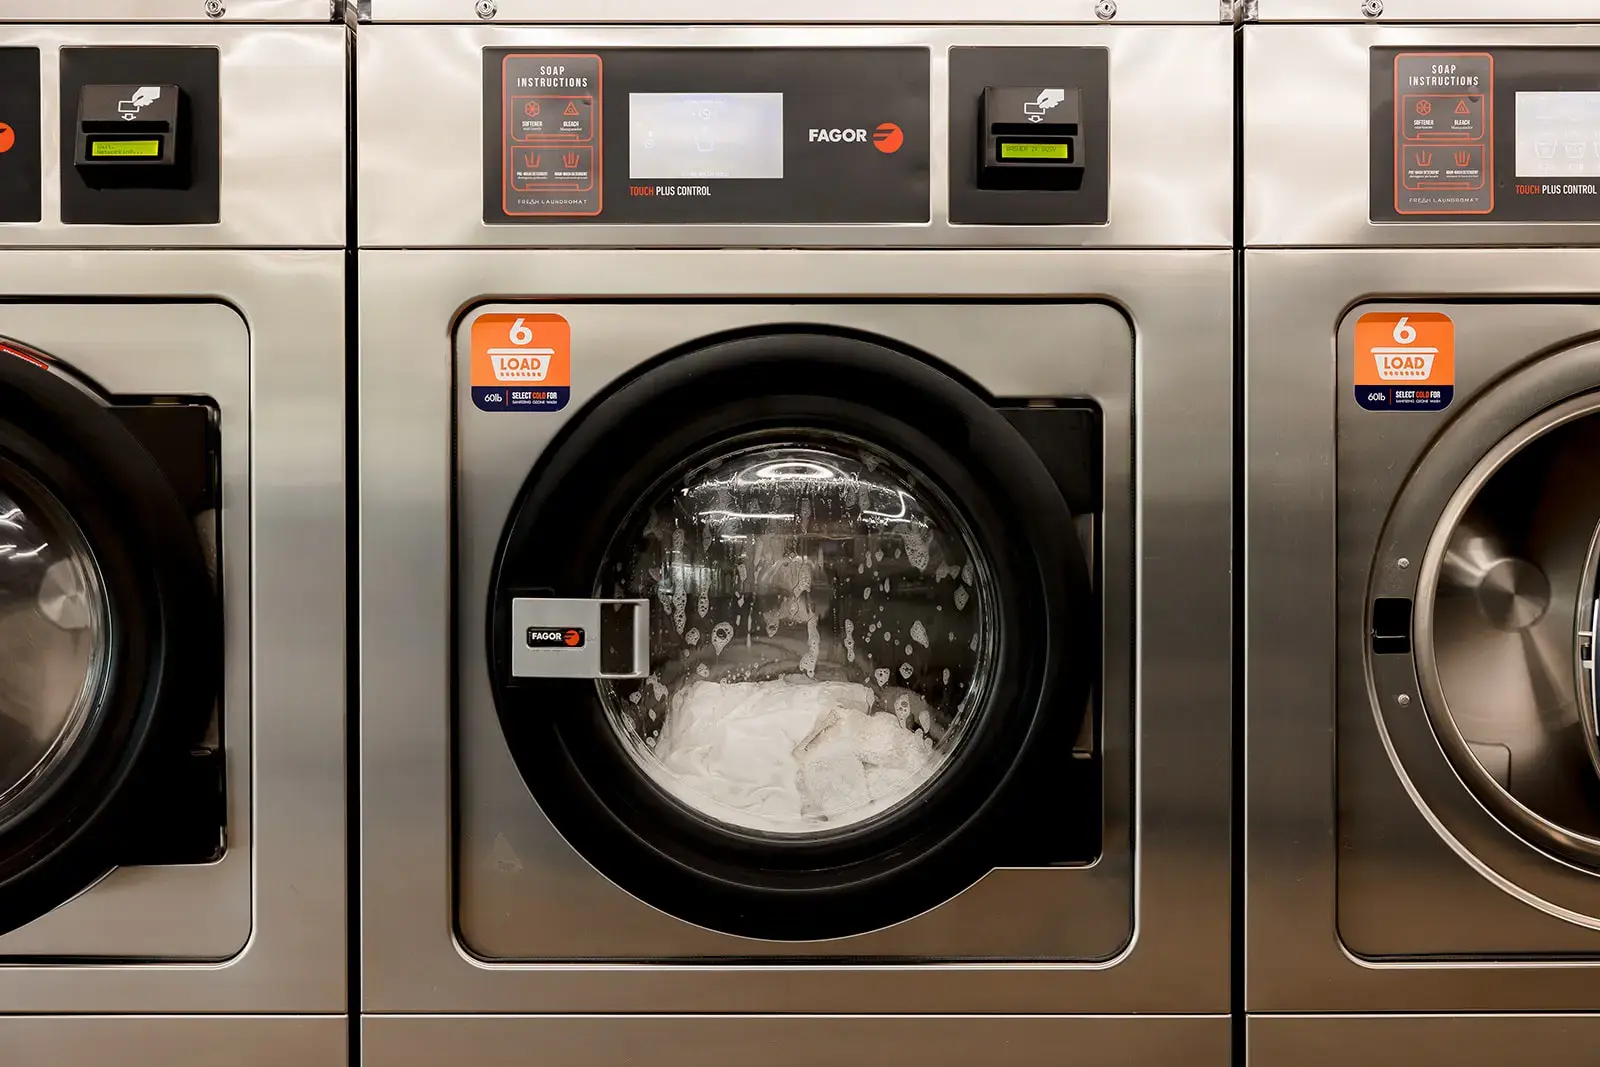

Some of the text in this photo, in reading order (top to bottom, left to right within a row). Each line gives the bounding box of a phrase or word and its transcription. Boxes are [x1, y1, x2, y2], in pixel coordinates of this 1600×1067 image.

[540, 66, 565, 76] SOAP
[1431, 64, 1457, 74] SOAP
[517, 77, 588, 88] INSTRUCTIONS
[1409, 76, 1479, 86] INSTRUCTIONS
[808, 128, 868, 142] FAGOR
[629, 186, 712, 196] TOUCH PLUS CONTROL
[1515, 184, 1598, 195] TOUCH PLUS CONTROL
[509, 317, 533, 345] 6
[1392, 316, 1417, 344] 6
[500, 358, 542, 371] LOAD
[1383, 356, 1426, 370] LOAD
[484, 393, 503, 403] 60lb
[511, 391, 558, 400] SELECT COLD FOR
[1367, 392, 1386, 401] 60lb
[1395, 390, 1441, 399] SELECT COLD FOR
[531, 632, 562, 640] FAGOR
